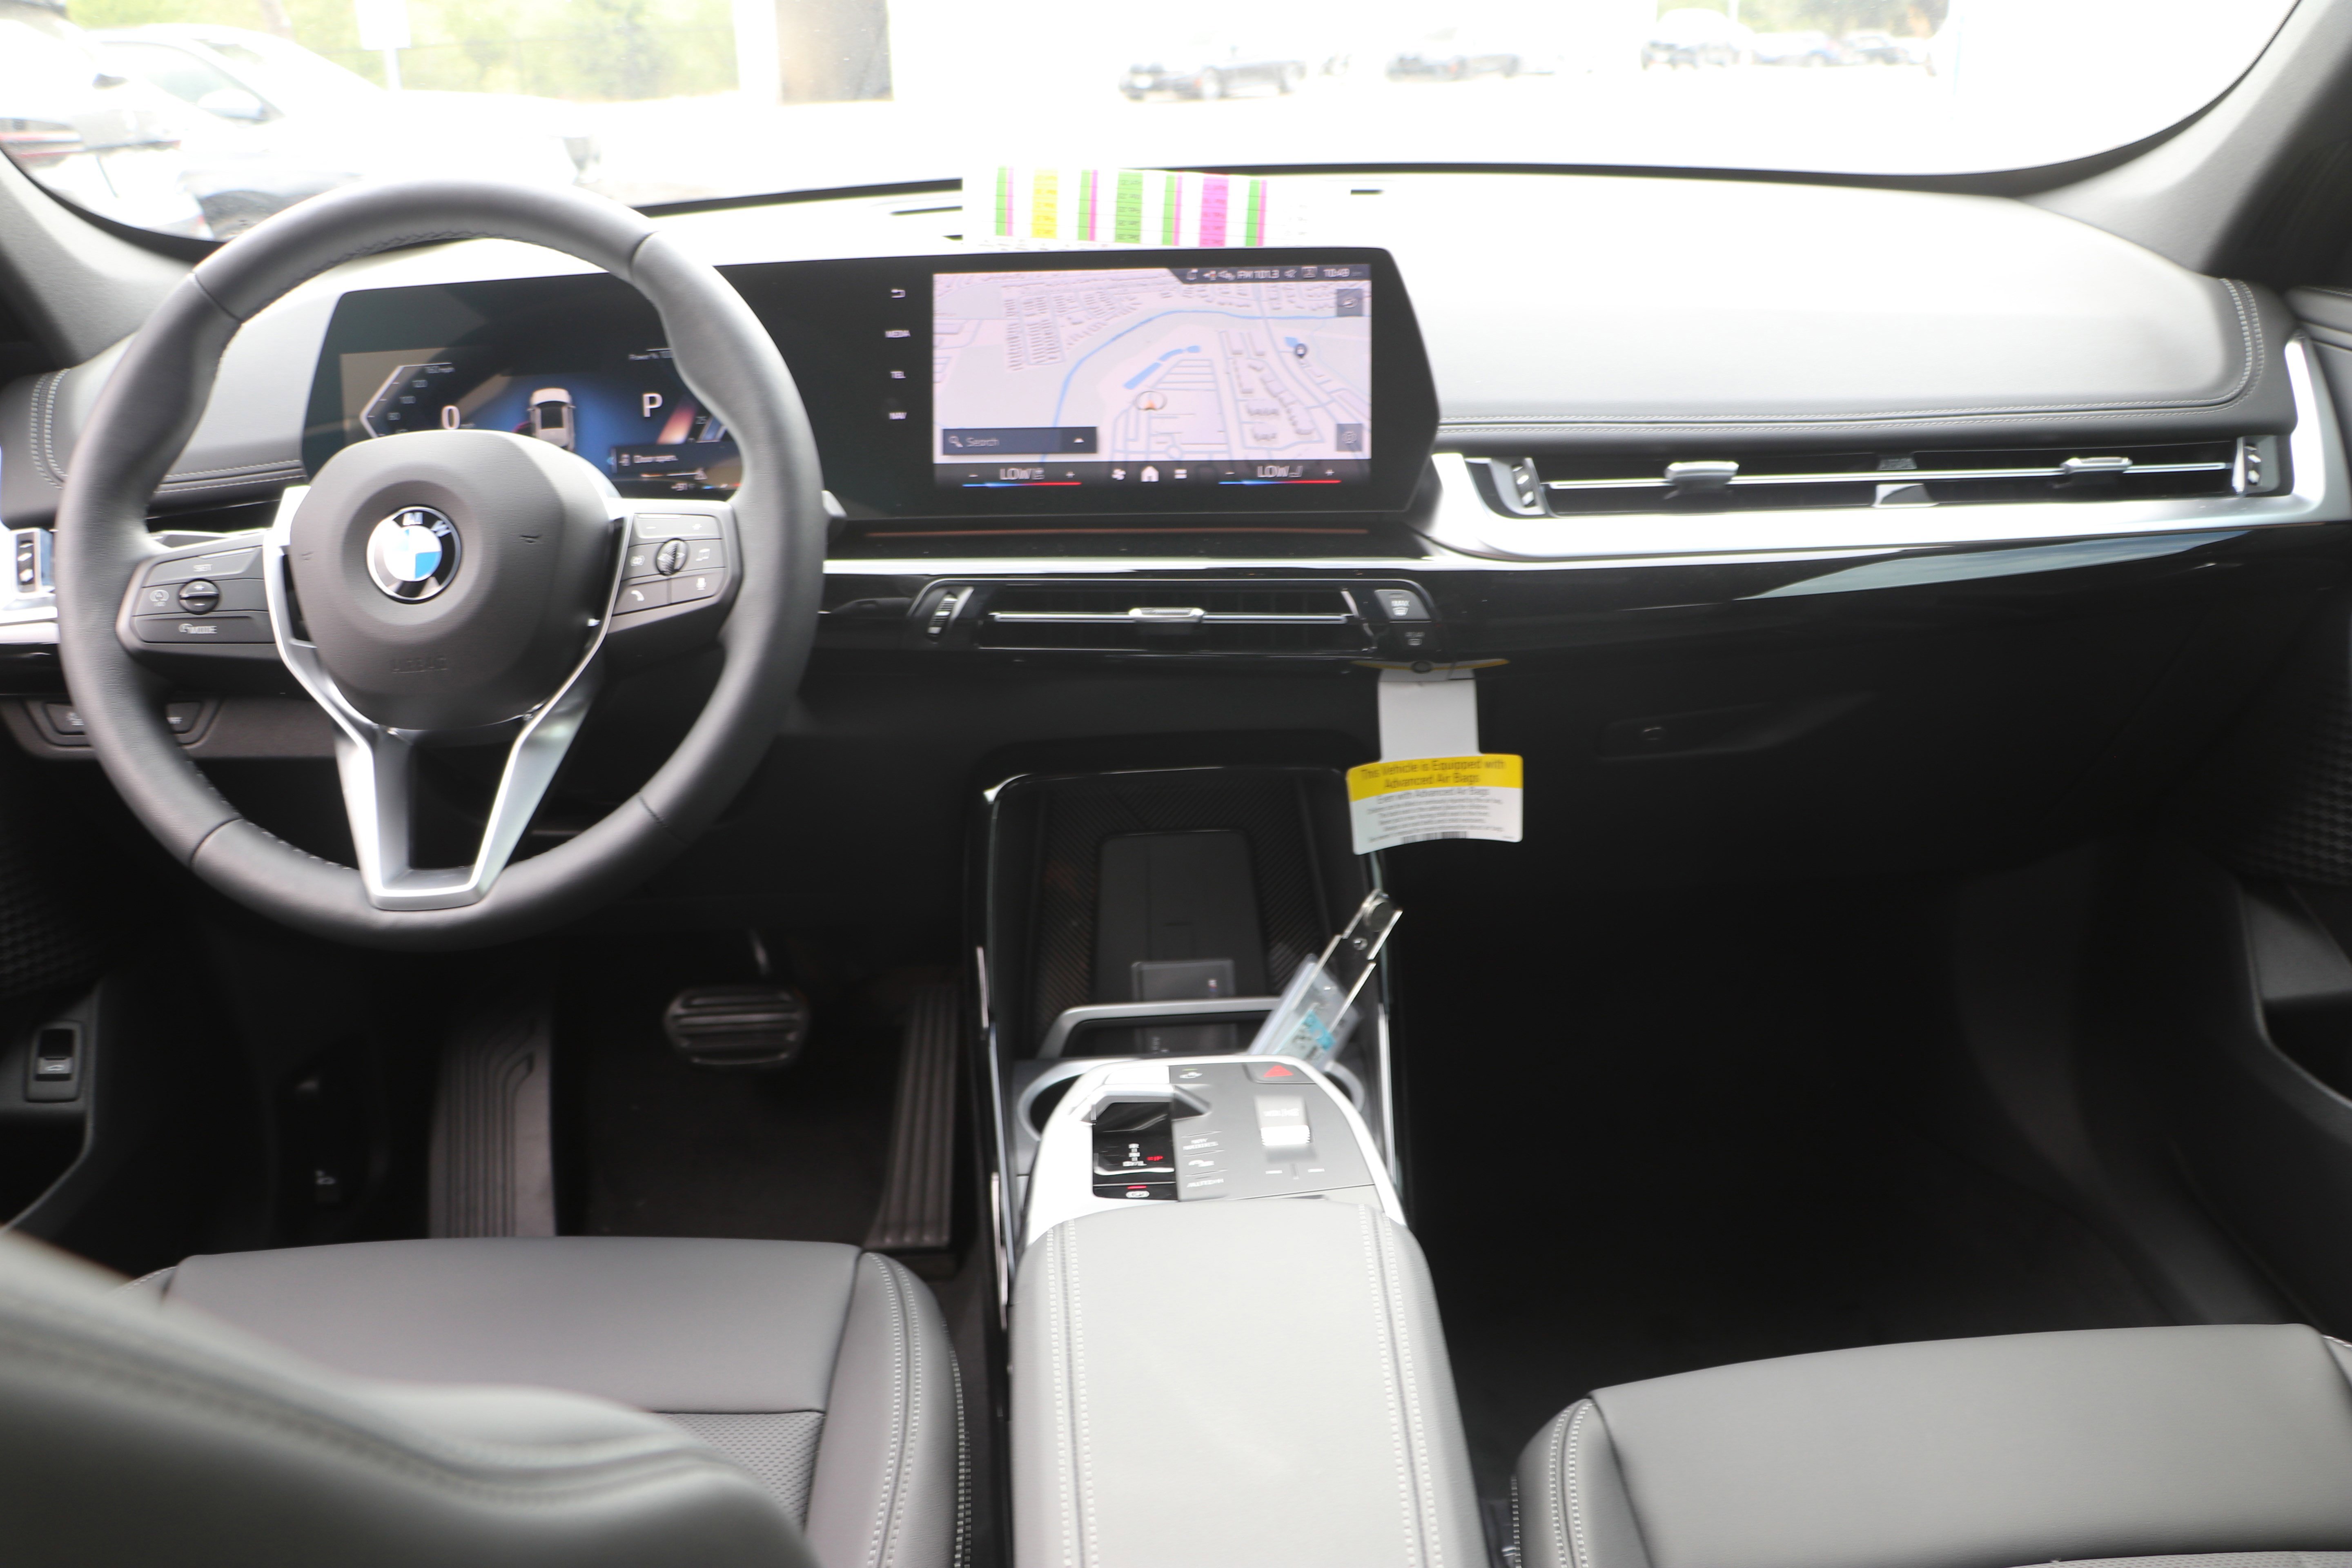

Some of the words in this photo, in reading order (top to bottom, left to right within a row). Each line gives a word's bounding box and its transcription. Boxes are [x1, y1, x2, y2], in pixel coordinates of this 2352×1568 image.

[1237, 271, 1254, 279] FM
[642, 393, 663, 417] P
[441, 405, 461, 429] 0
[966, 437, 999, 447] Search
[1000, 468, 1031, 481] LOW
[1257, 466, 1290, 478] LOW
[193, 564, 213, 572] SET
[1381, 763, 1418, 775] Vehicle
[1431, 759, 1482, 772] Equipped
[1484, 759, 1506, 769] with
[1384, 775, 1433, 789] Advanced
[1436, 773, 1450, 784] Air
[1453, 772, 1480, 786] Bags
[1397, 792, 1412, 801] with
[1414, 788, 1454, 798] Advanced
